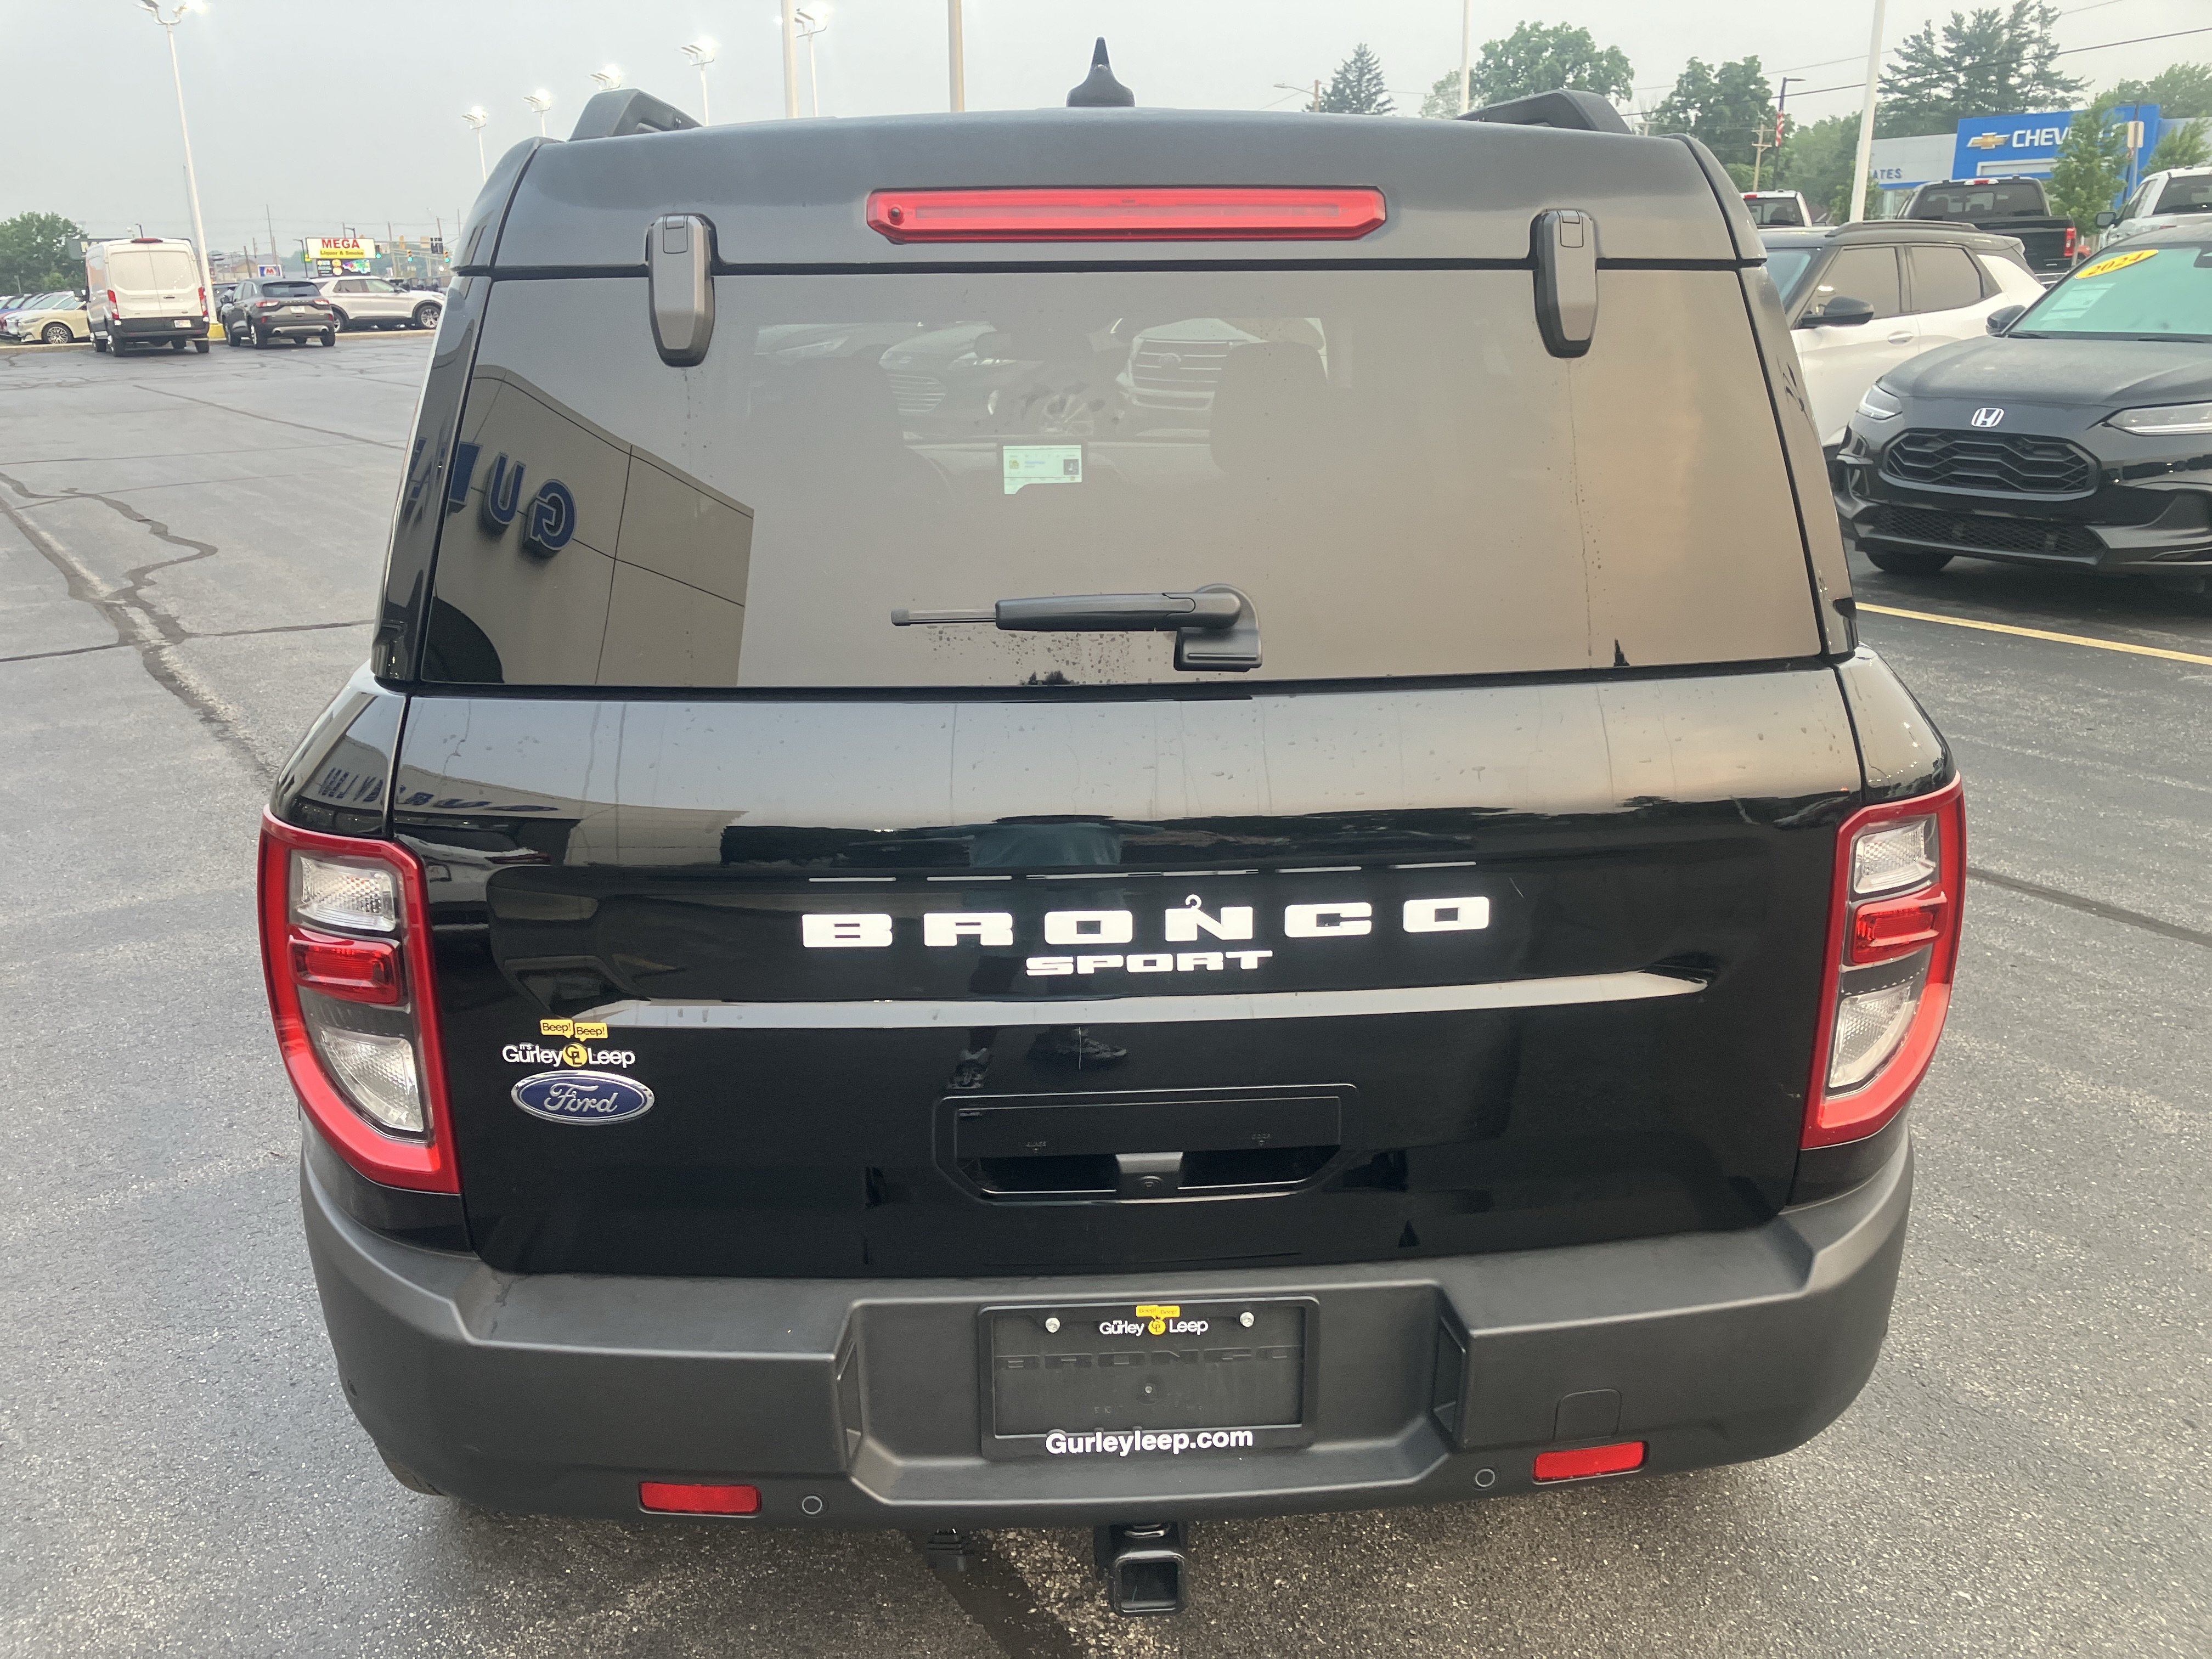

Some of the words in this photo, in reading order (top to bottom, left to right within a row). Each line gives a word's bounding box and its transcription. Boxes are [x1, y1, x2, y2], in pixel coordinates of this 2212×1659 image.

[1872, 168, 1902, 179] ATES
[321, 238, 360, 249] MEGA
[2087, 252, 2145, 275] 2024
[802, 895, 1490, 948] BRONCO
[1026, 950, 1273, 976] SPORT
[543, 1023, 572, 1033] Beep!
[577, 1026, 605, 1037] Beep!
[502, 1045, 563, 1067] Gurley
[587, 1047, 636, 1068] Leep
[544, 1082, 619, 1113] Ford
[1099, 1320, 1145, 1336] Gurley
[1169, 1319, 1209, 1335] Leep
[1045, 1430, 1253, 1457] Gurleyleep.com
